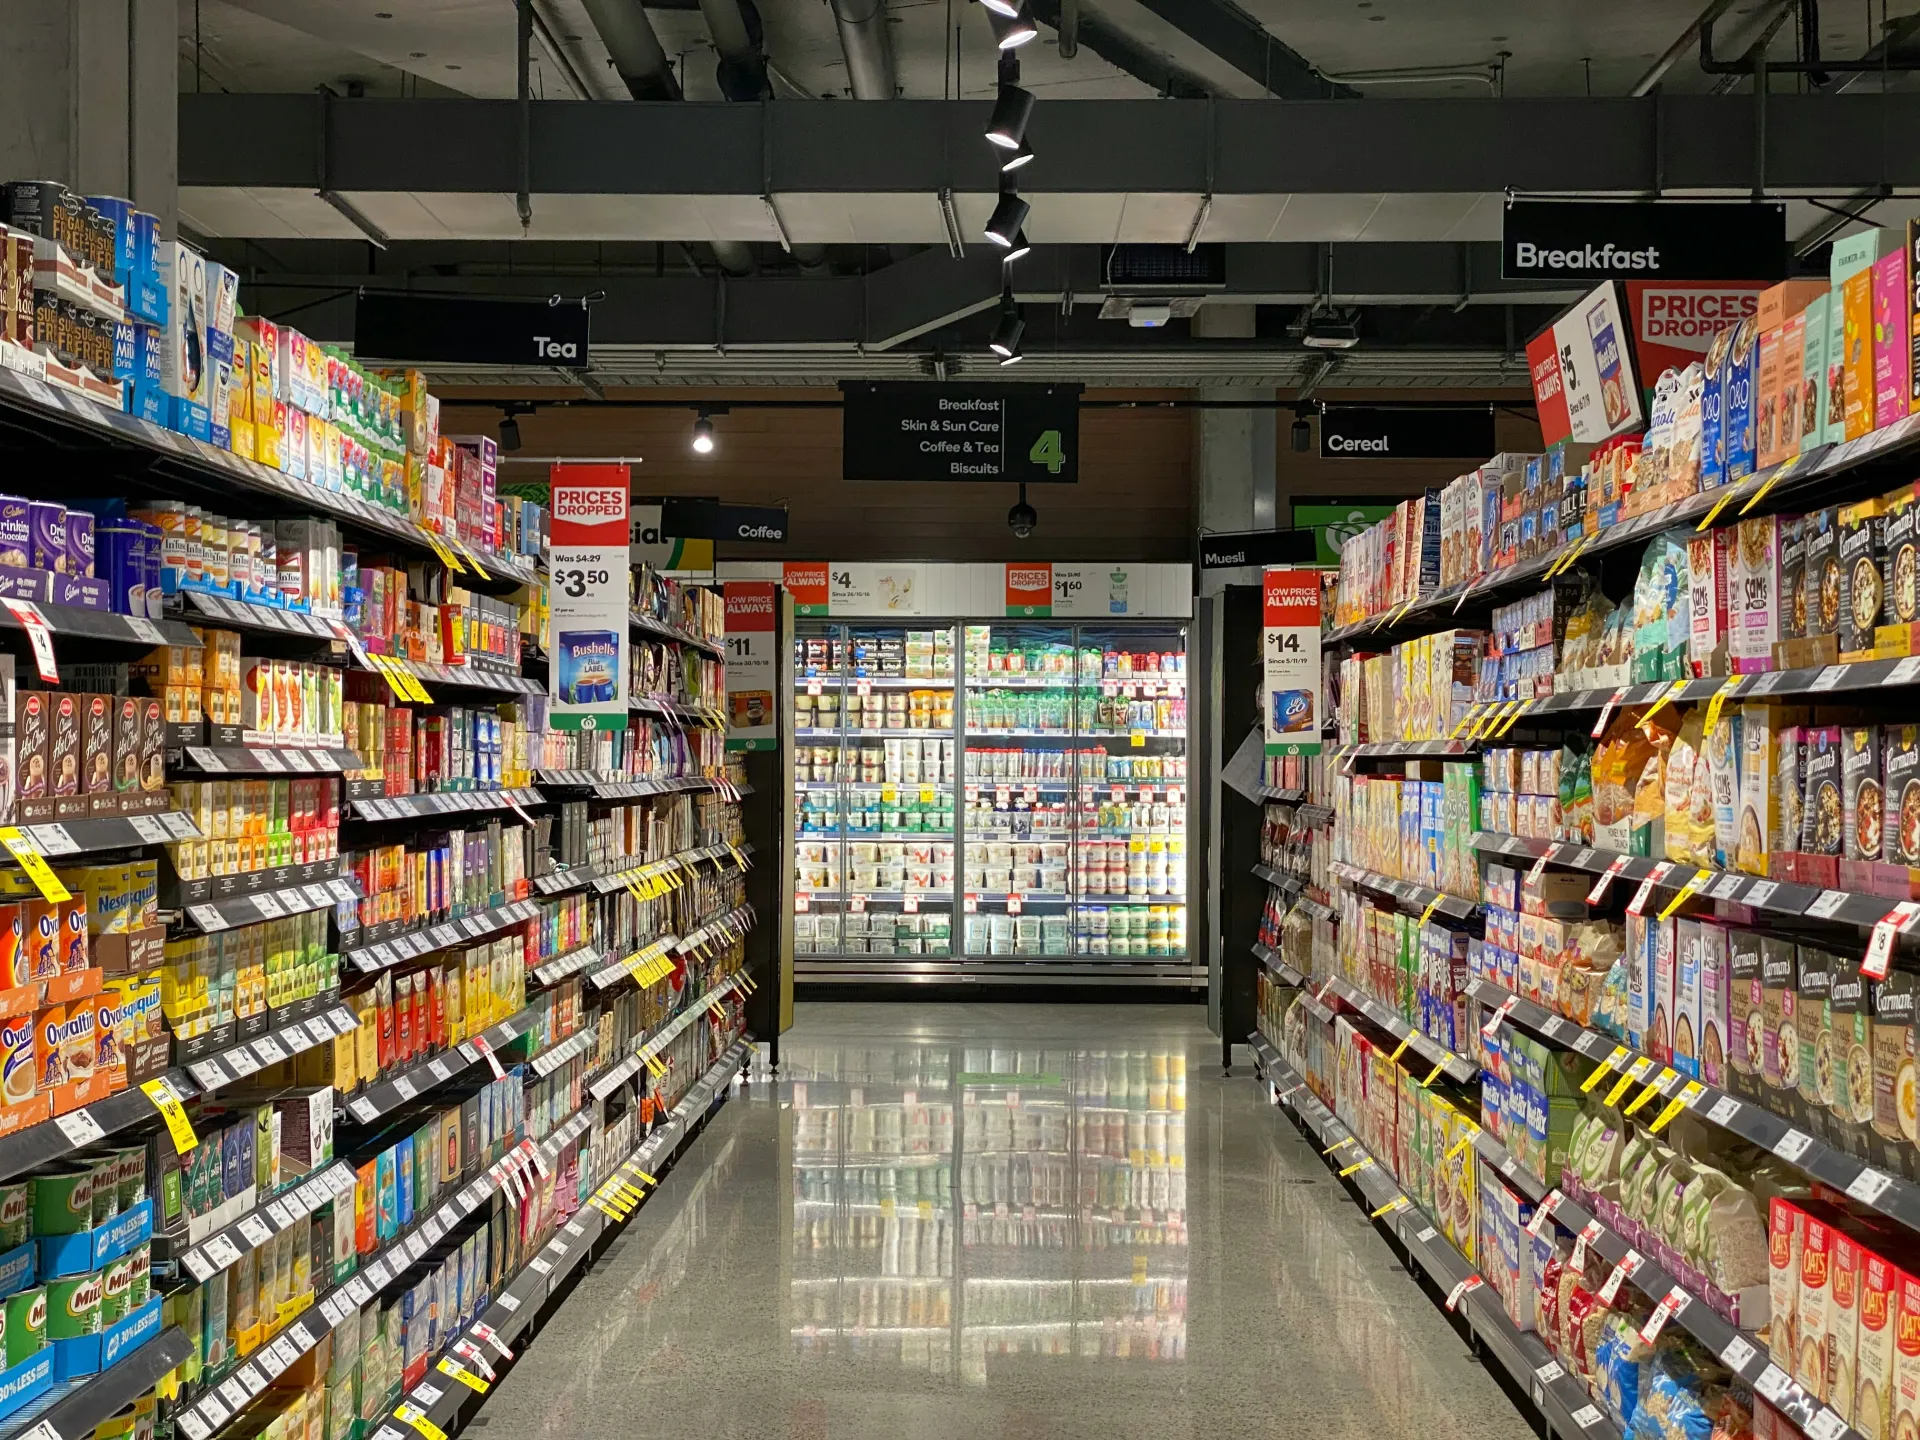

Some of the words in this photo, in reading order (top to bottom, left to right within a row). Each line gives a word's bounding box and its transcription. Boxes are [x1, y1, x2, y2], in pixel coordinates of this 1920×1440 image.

[1516, 242, 1660, 270] Breakfast
[1648, 295, 1758, 318] PRICES
[533, 336, 577, 358] Tea
[1537, 371, 1561, 402] ALWAYS
[939, 398, 999, 411] Breakfast
[901, 419, 928, 431] Skin
[930, 420, 940, 432] &
[942, 420, 967, 432] Sun
[969, 421, 999, 432] Care
[920, 441, 960, 453] Coffee
[963, 442, 973, 453] &
[975, 442, 999, 453] Tea
[1029, 429, 1066, 473] 4
[1328, 434, 1389, 452] Cereal
[950, 463, 999, 474] Biscuits
[558, 490, 622, 504] PRICES
[558, 505, 622, 516] DROPPED
[738, 525, 783, 539] Coffee
[1884, 505, 1914, 546] Carman's
[1807, 524, 1834, 557] Carman's
[1840, 520, 1870, 558] Carman's
[555, 554, 574, 562] Was
[1205, 551, 1246, 565] Muesli
[786, 578, 826, 586] ALWAYS
[832, 572, 851, 588] $4
[1011, 572, 1047, 580] PRICES
[727, 604, 772, 613] ALWAYS
[1267, 597, 1317, 606] ALWAYS
[573, 642, 615, 658] Bushells
[728, 638, 749, 656] $11
[1268, 633, 1299, 652] $14
[584, 665, 604, 673] LABEL
[1286, 703, 1305, 715] GO
[1844, 744, 1871, 777] Carman's
[1886, 744, 1918, 774] Carman's
[1731, 944, 1758, 969] Carman's
[1763, 953, 1790, 978] Carman's
[1831, 973, 1861, 999] Carman's
[1875, 1033, 1900, 1056] Porridge
[1775, 1205, 1787, 1220] UNCLE
[111, 1227, 124, 1243] 30%
[123, 1217, 137, 1234] LESS
[1775, 1218, 1786, 1232] TOBYS
[1810, 1222, 1824, 1238] UNCLE
[1771, 1230, 1788, 1256] OATS
[1809, 1233, 1823, 1252] TOBYS
[1837, 1238, 1850, 1254] UNCLE
[1803, 1248, 1825, 1277] OATS
[1869, 1257, 1884, 1276] UNCLE
[1834, 1267, 1852, 1296] OATS
[1868, 1272, 1884, 1292] TOBYS
[1863, 1287, 1885, 1317] OATS
[121, 1329, 135, 1345] 30%
[134, 1319, 148, 1338] LESS
[17, 1369, 36, 1391] LESS
